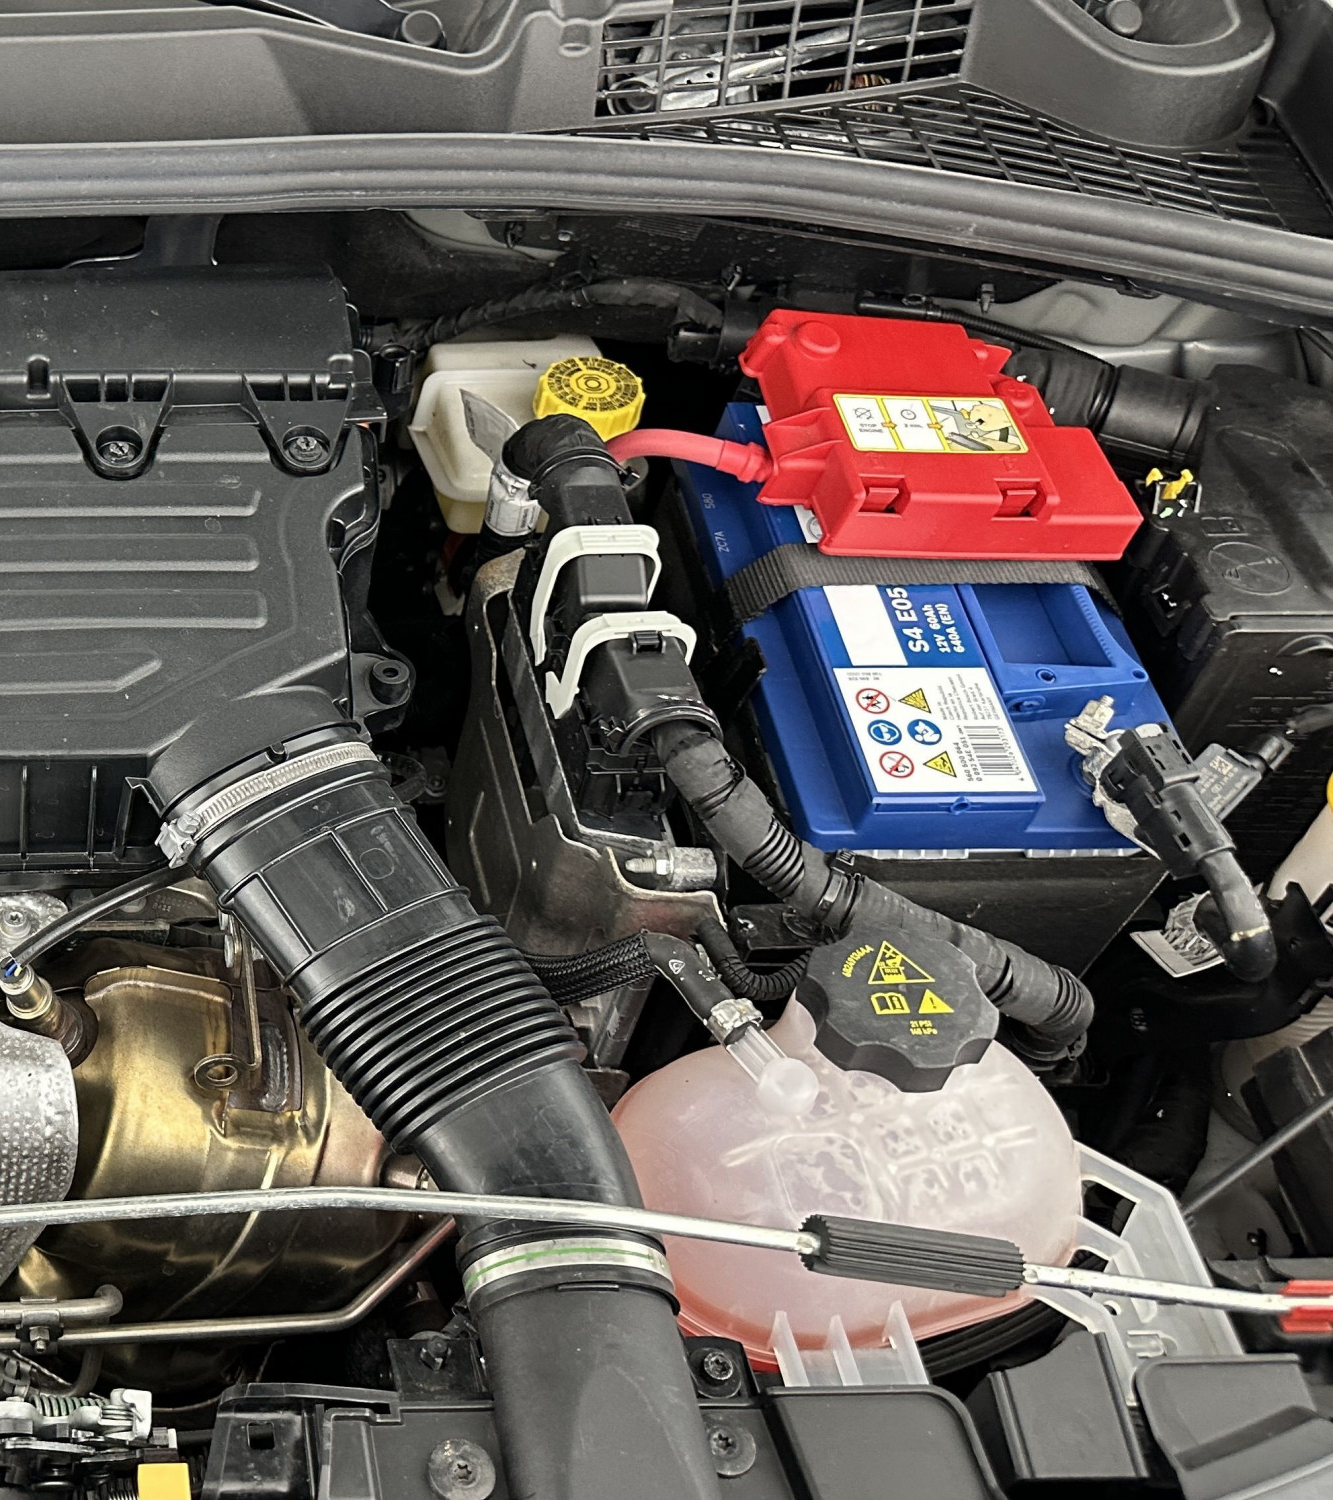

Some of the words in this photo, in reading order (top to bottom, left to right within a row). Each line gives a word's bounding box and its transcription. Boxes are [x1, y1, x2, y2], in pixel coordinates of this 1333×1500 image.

[714, 531, 730, 553] ZC7A
[886, 587, 918, 621] E05
[922, 604, 942, 630] 60Ah
[935, 603, 955, 625] (EN)
[902, 627, 930, 653] S4
[933, 634, 952, 653] 12V
[946, 626, 966, 653] 640A
